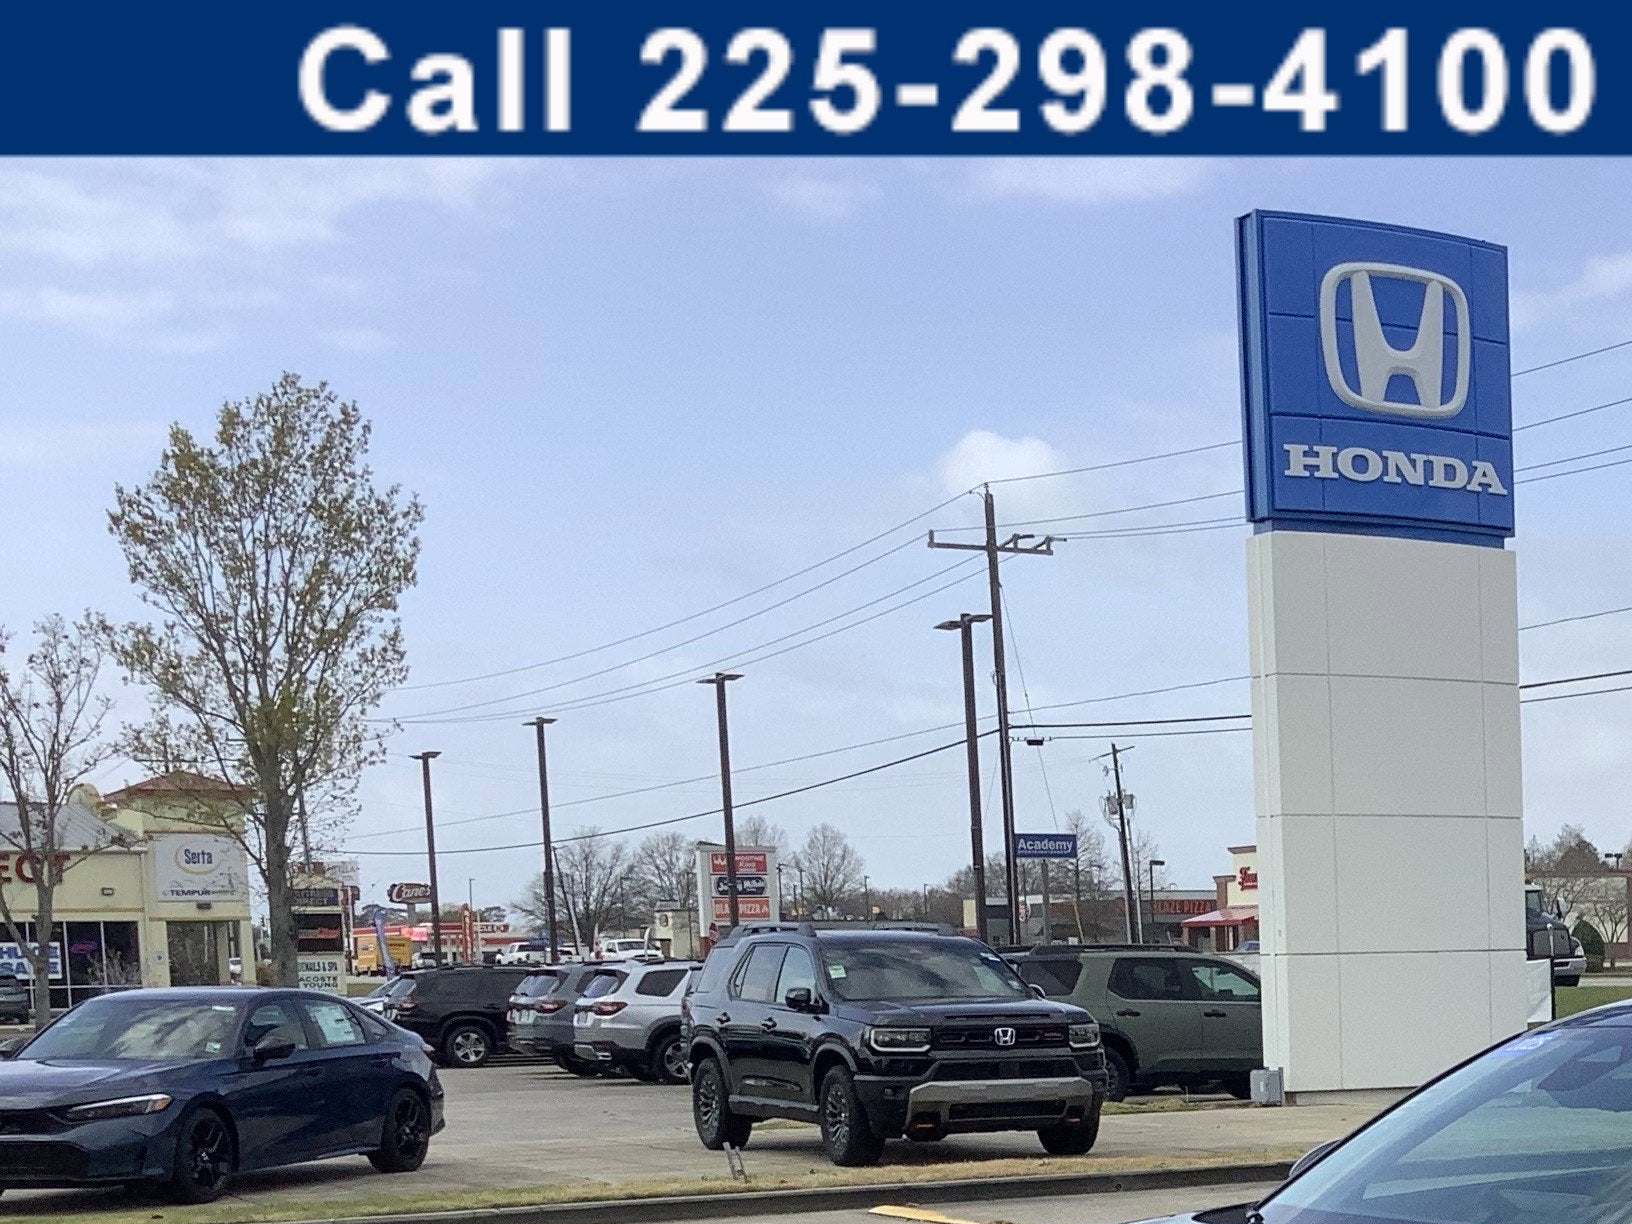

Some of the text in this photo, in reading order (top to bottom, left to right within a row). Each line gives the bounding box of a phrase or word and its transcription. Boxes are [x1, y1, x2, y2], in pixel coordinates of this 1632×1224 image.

[1282, 443, 1509, 496] HONDA
[1017, 838, 1074, 853] Academy
[183, 848, 213, 865] Serta
[391, 884, 431, 903] Cane's
[0, 961, 59, 974] SAE
